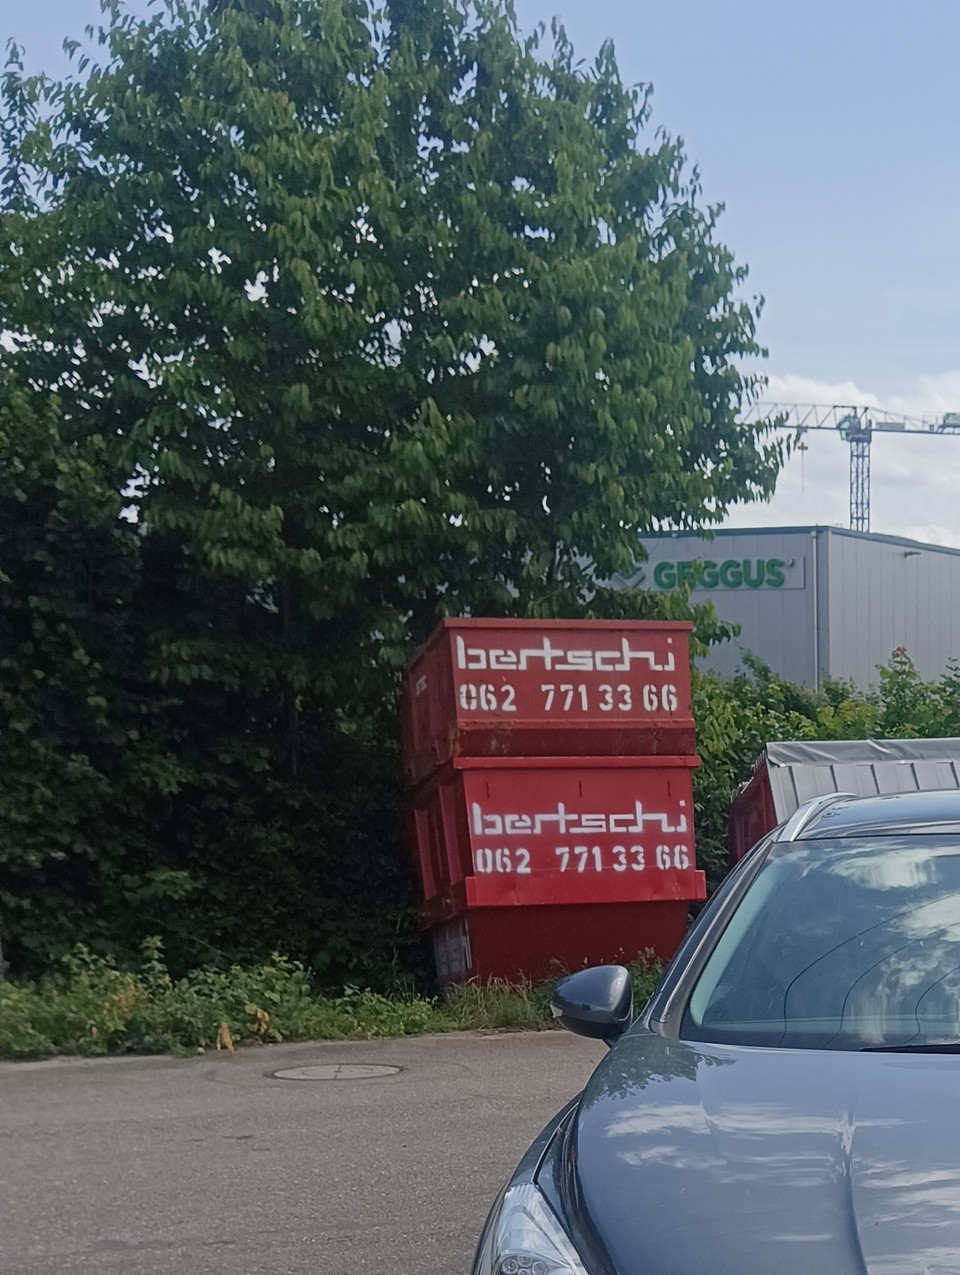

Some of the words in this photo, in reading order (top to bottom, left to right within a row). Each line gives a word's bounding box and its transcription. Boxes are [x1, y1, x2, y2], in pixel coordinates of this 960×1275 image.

[456, 635, 675, 671] bertschi
[459, 684, 517, 711] 062
[541, 684, 588, 711] 771
[598, 684, 632, 711] 33
[643, 684, 678, 712] 66
[471, 800, 687, 835] bertschi
[475, 848, 531, 874] 062
[555, 846, 602, 873] 771
[612, 845, 645, 871] 33
[655, 844, 689, 870] 66
